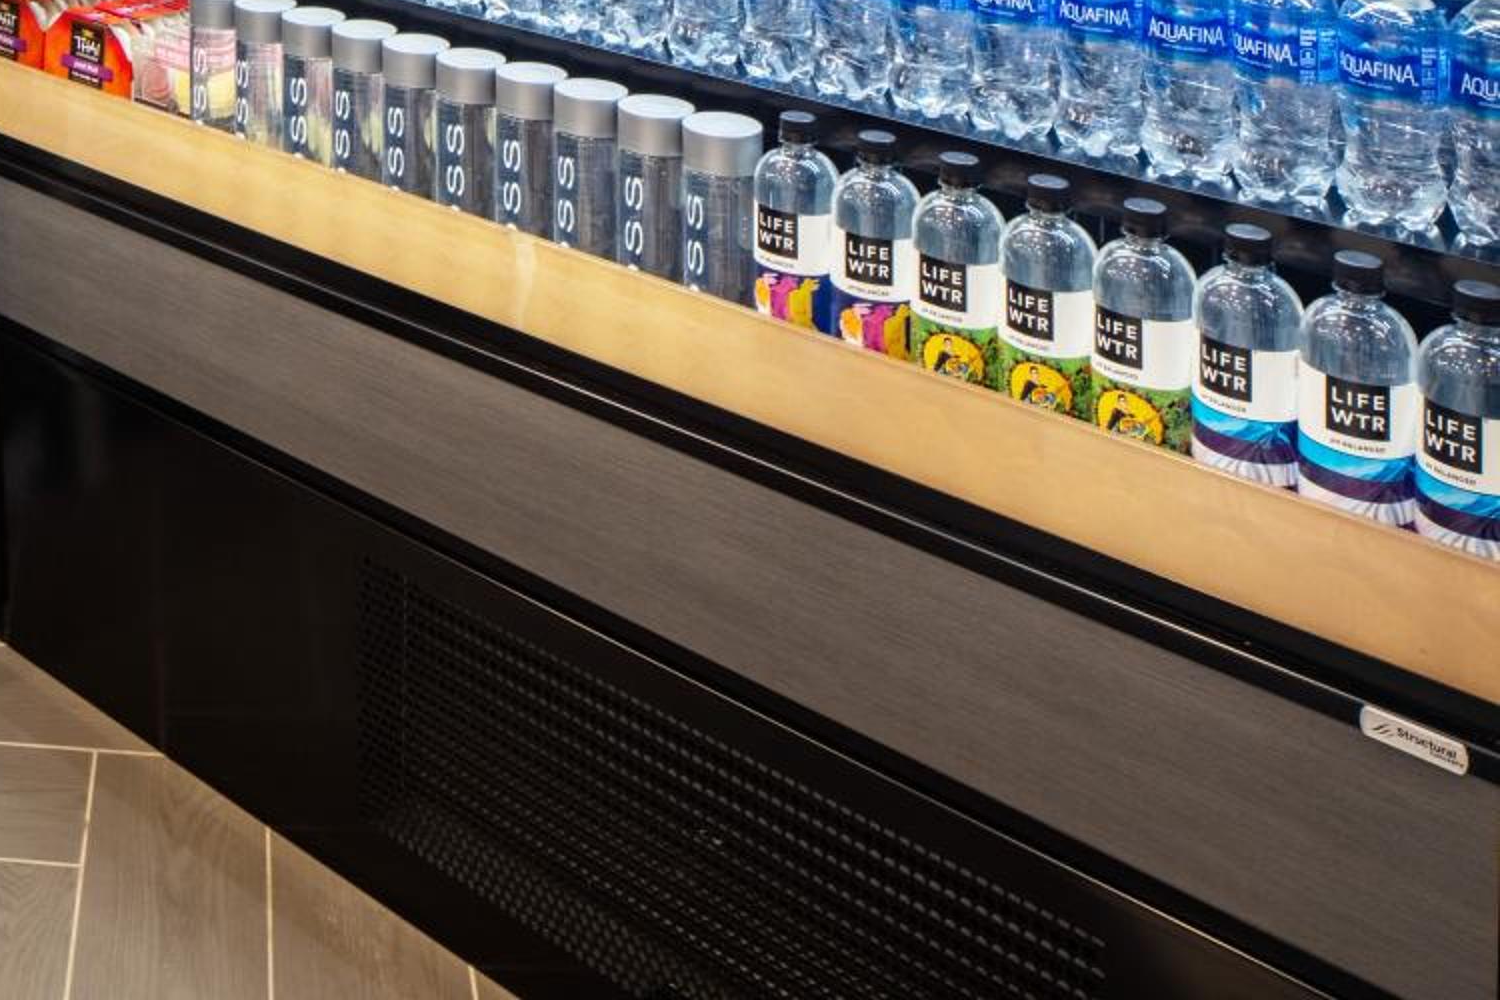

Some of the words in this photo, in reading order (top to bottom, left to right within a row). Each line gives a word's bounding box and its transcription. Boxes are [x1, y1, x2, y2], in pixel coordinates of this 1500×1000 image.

[1059, 0, 1132, 28] AQUAFINA
[1148, 17, 1227, 47] AQUAFINA
[758, 211, 796, 234] LIFE
[758, 228, 795, 252] WTR
[849, 239, 891, 261] LIFE
[848, 257, 891, 280] WTR
[921, 263, 963, 286] LIFE
[920, 280, 964, 305] WTR
[1008, 288, 1049, 313] LIFE
[1008, 306, 1050, 332] WTR
[1097, 314, 1138, 339] LIFE
[1097, 333, 1138, 361] WTR
[1202, 343, 1247, 372] LIFE
[1201, 363, 1247, 393] WTR
[1331, 385, 1386, 410] LIFE
[1331, 407, 1386, 432] WTR
[1426, 408, 1477, 441] LIFE
[1424, 430, 1476, 463] WTR
